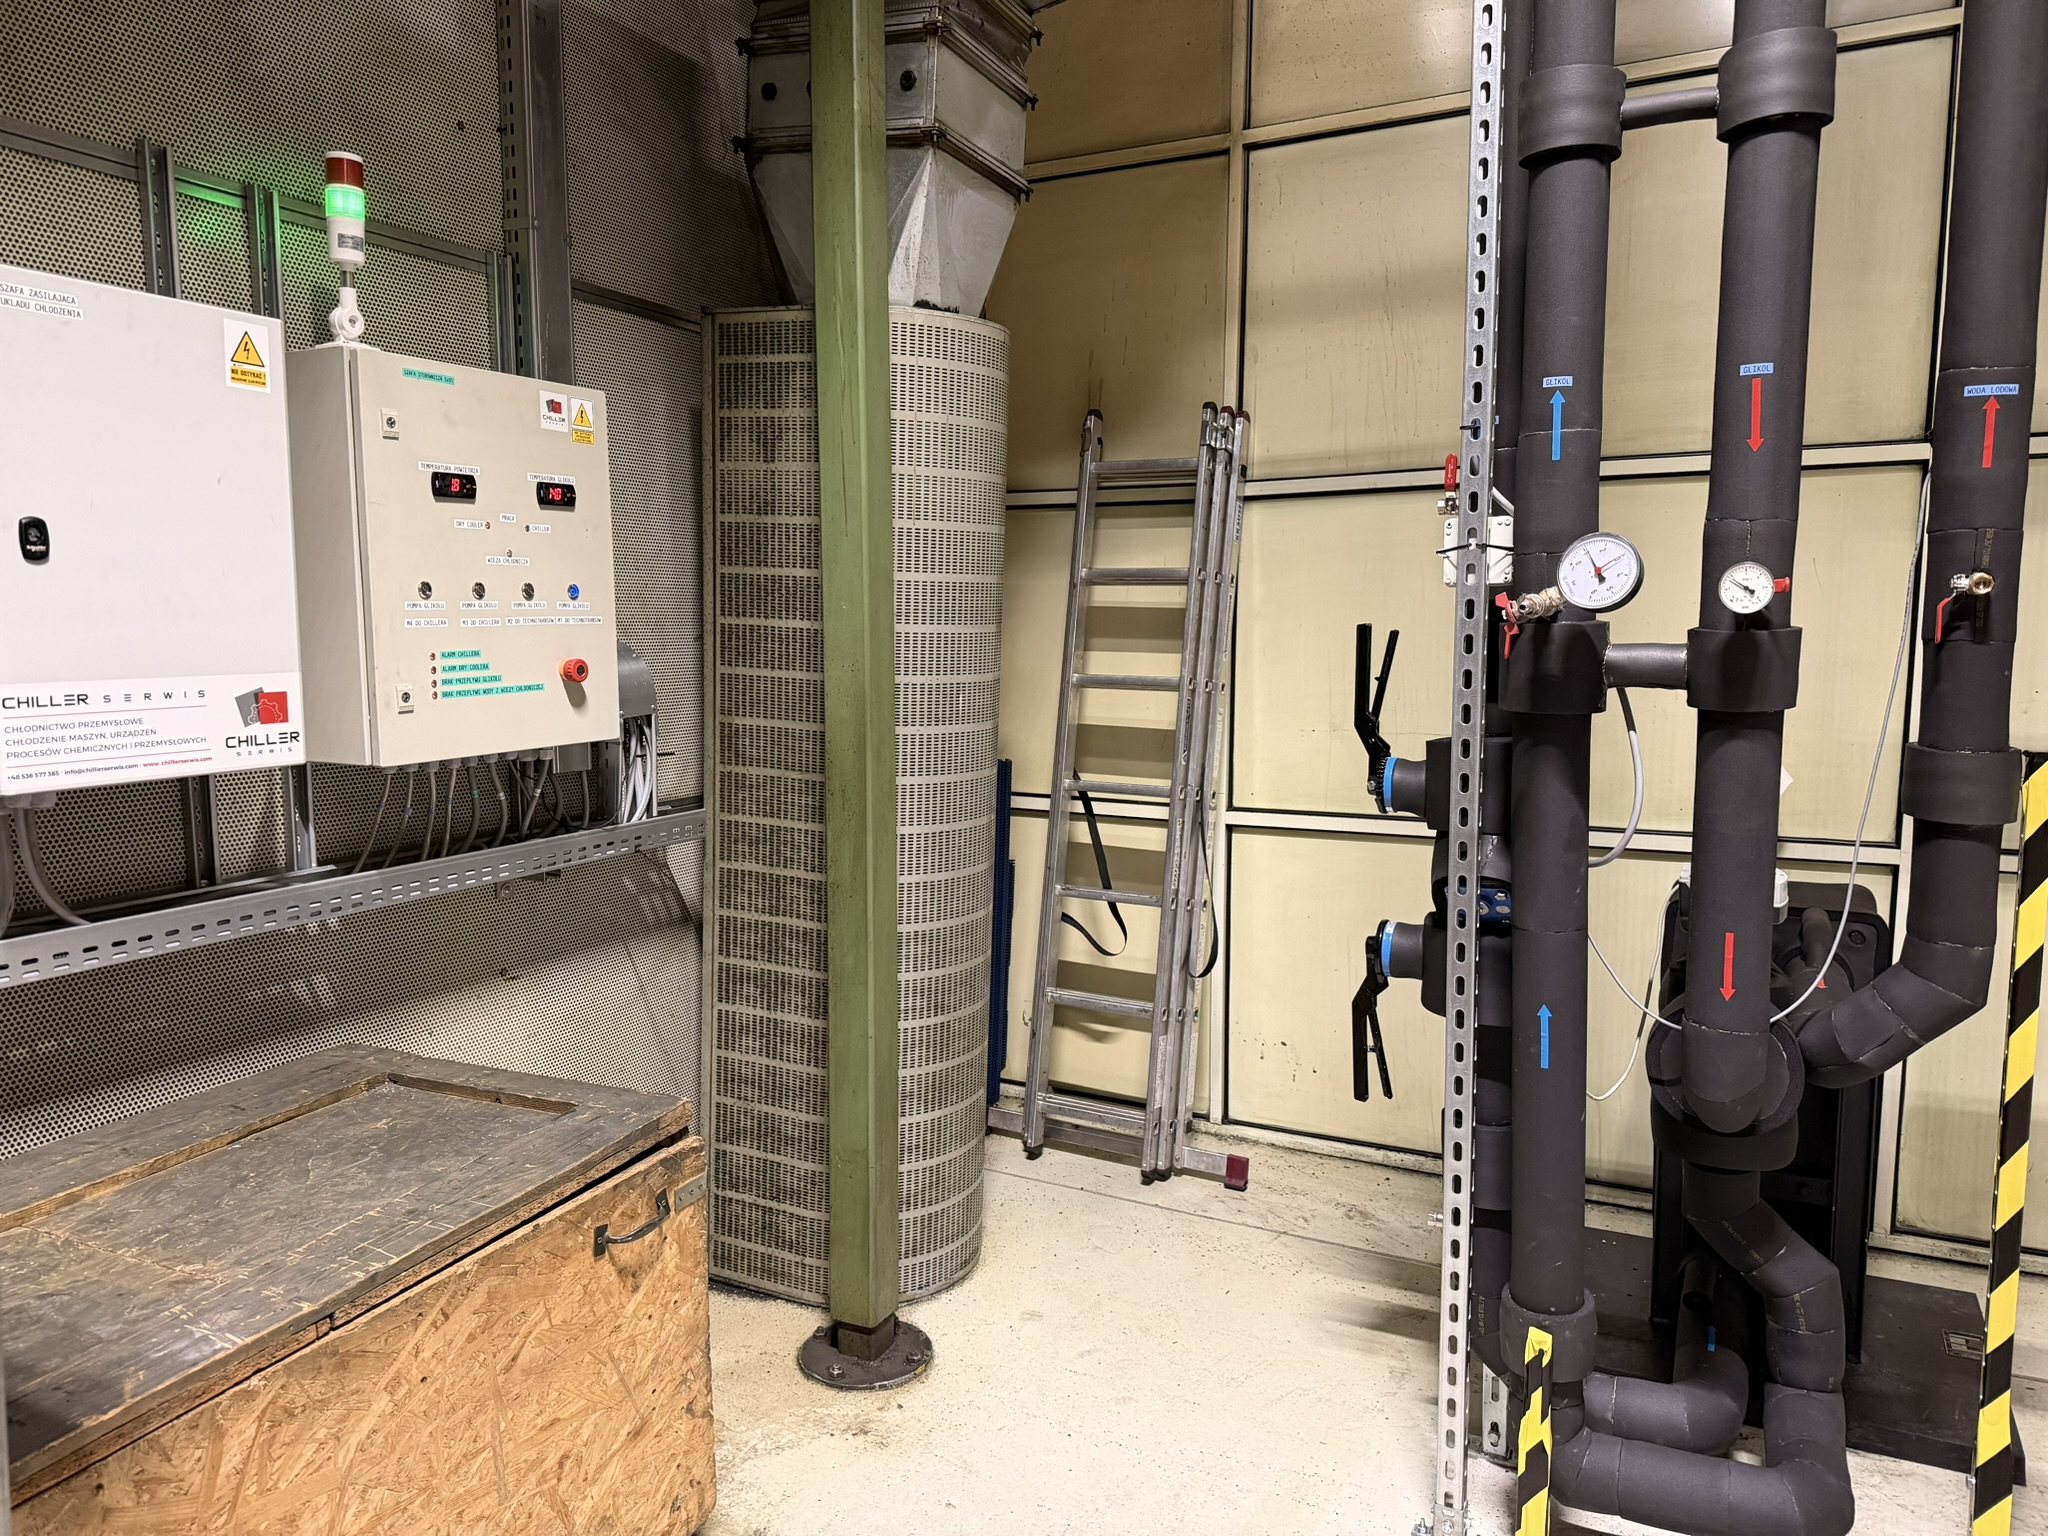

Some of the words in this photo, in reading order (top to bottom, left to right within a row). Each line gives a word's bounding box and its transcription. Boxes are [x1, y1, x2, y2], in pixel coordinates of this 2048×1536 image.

[0, 283, 24, 295] SZAFA
[29, 288, 77, 304] ZASILAJACA
[0, 297, 30, 309] UKLADU
[34, 303, 82, 318] CHLODZENIA
[1743, 365, 1771, 374] GLIKOL
[1545, 377, 1571, 386] GLIKOL
[1967, 387, 1986, 395] WODA
[1990, 385, 2017, 393] LODOWA
[420, 462, 451, 471] TEMPERATURA
[442, 664, 457, 672] ALARM
[2, 693, 89, 709] CHILLER
[103, 689, 206, 703] SERWIS
[4, 722, 76, 734] CHŁODNICTWO
[78, 717, 144, 729] PRZEMYSŁOWE
[5, 735, 67, 747] CHŁODZENIE
[225, 731, 300, 748] CHILLER
[6, 747, 62, 759] PROCESÓW
[63, 742, 128, 755] CHEMICZNYCH
[134, 736, 207, 748] PRZEMYSŁOWYCH
[236, 747, 293, 757] SERWIS
